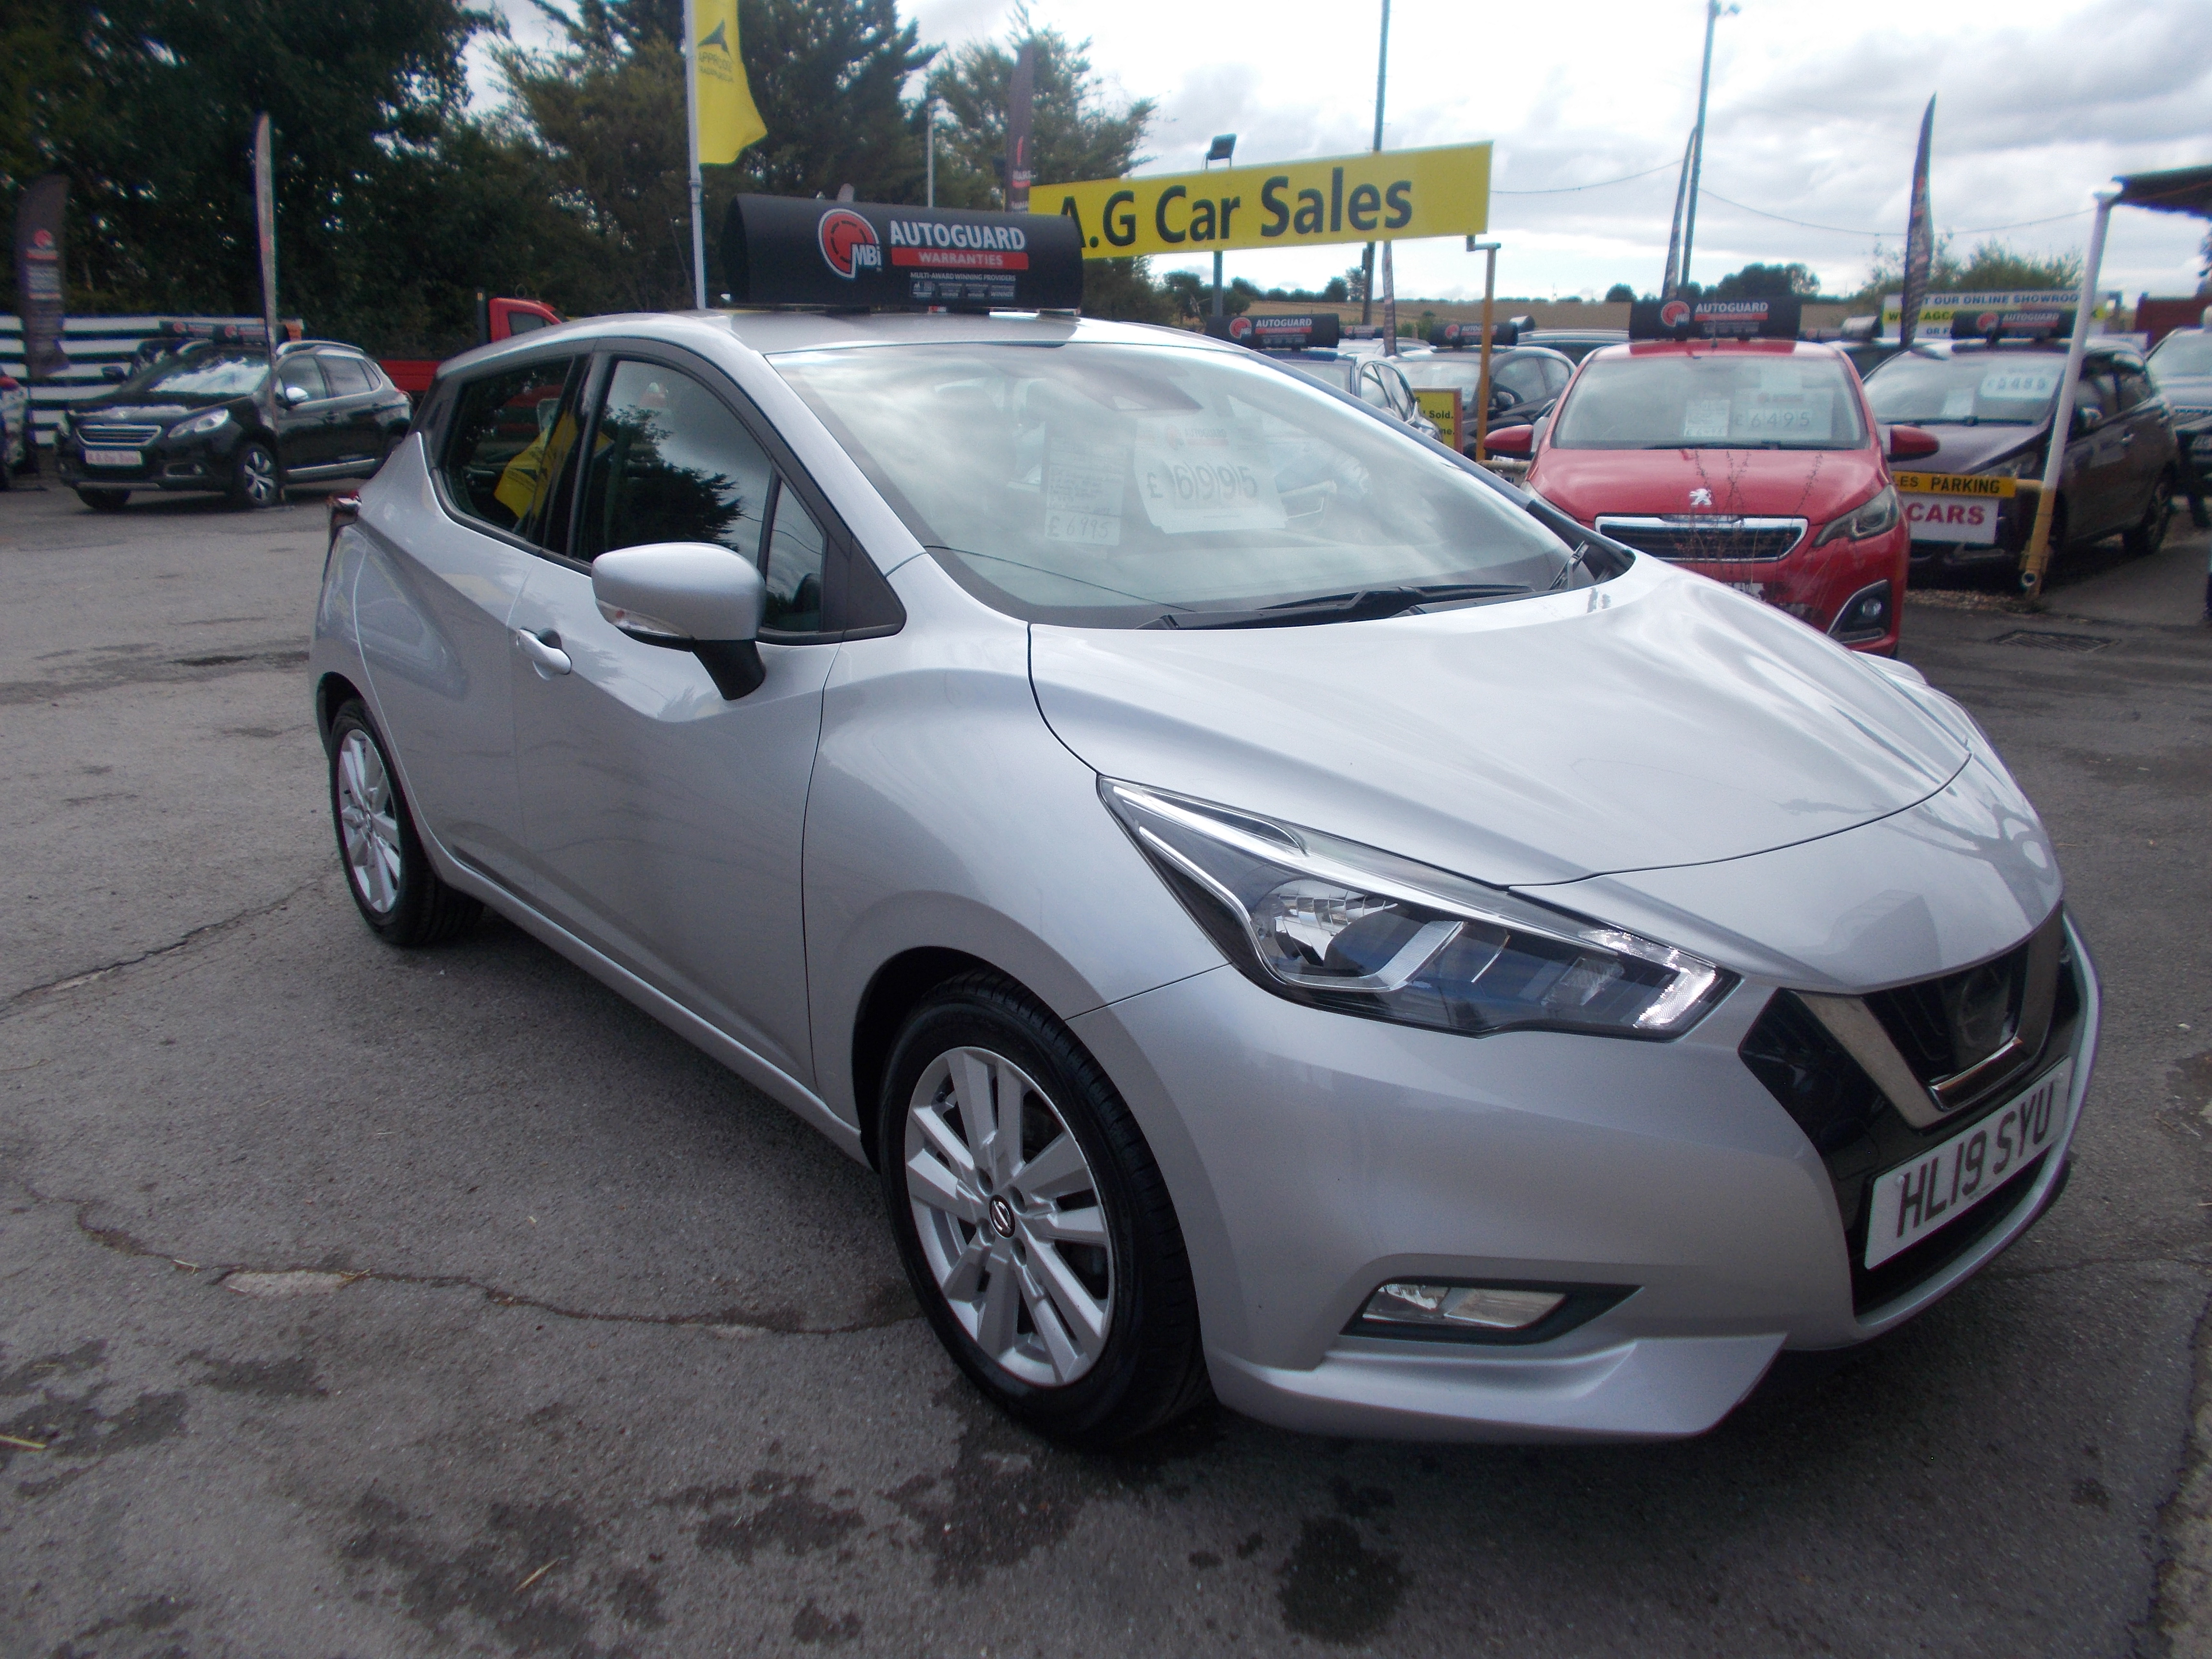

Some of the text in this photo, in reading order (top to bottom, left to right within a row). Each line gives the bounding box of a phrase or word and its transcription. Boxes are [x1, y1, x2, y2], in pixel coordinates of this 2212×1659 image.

[1059, 166, 1413, 248] A.G Car Sales
[890, 219, 1026, 251] AUTOGUARD
[918, 251, 1003, 266] WARRANTIES
[1935, 296, 1960, 305] OUR
[1963, 295, 2008, 305] ONLINE
[2013, 293, 2079, 304] SHOWROO
[1695, 301, 1768, 313] AUTOGUARD
[1256, 318, 1312, 327] AUTOGUARD
[2002, 313, 2059, 322] AUTOGUARD
[1429, 409, 1454, 419] Sold.
[1930, 477, 2000, 494] PARKING
[1906, 502, 1985, 526] CARS
[1897, 1081, 2054, 1238] HL19 SYU
